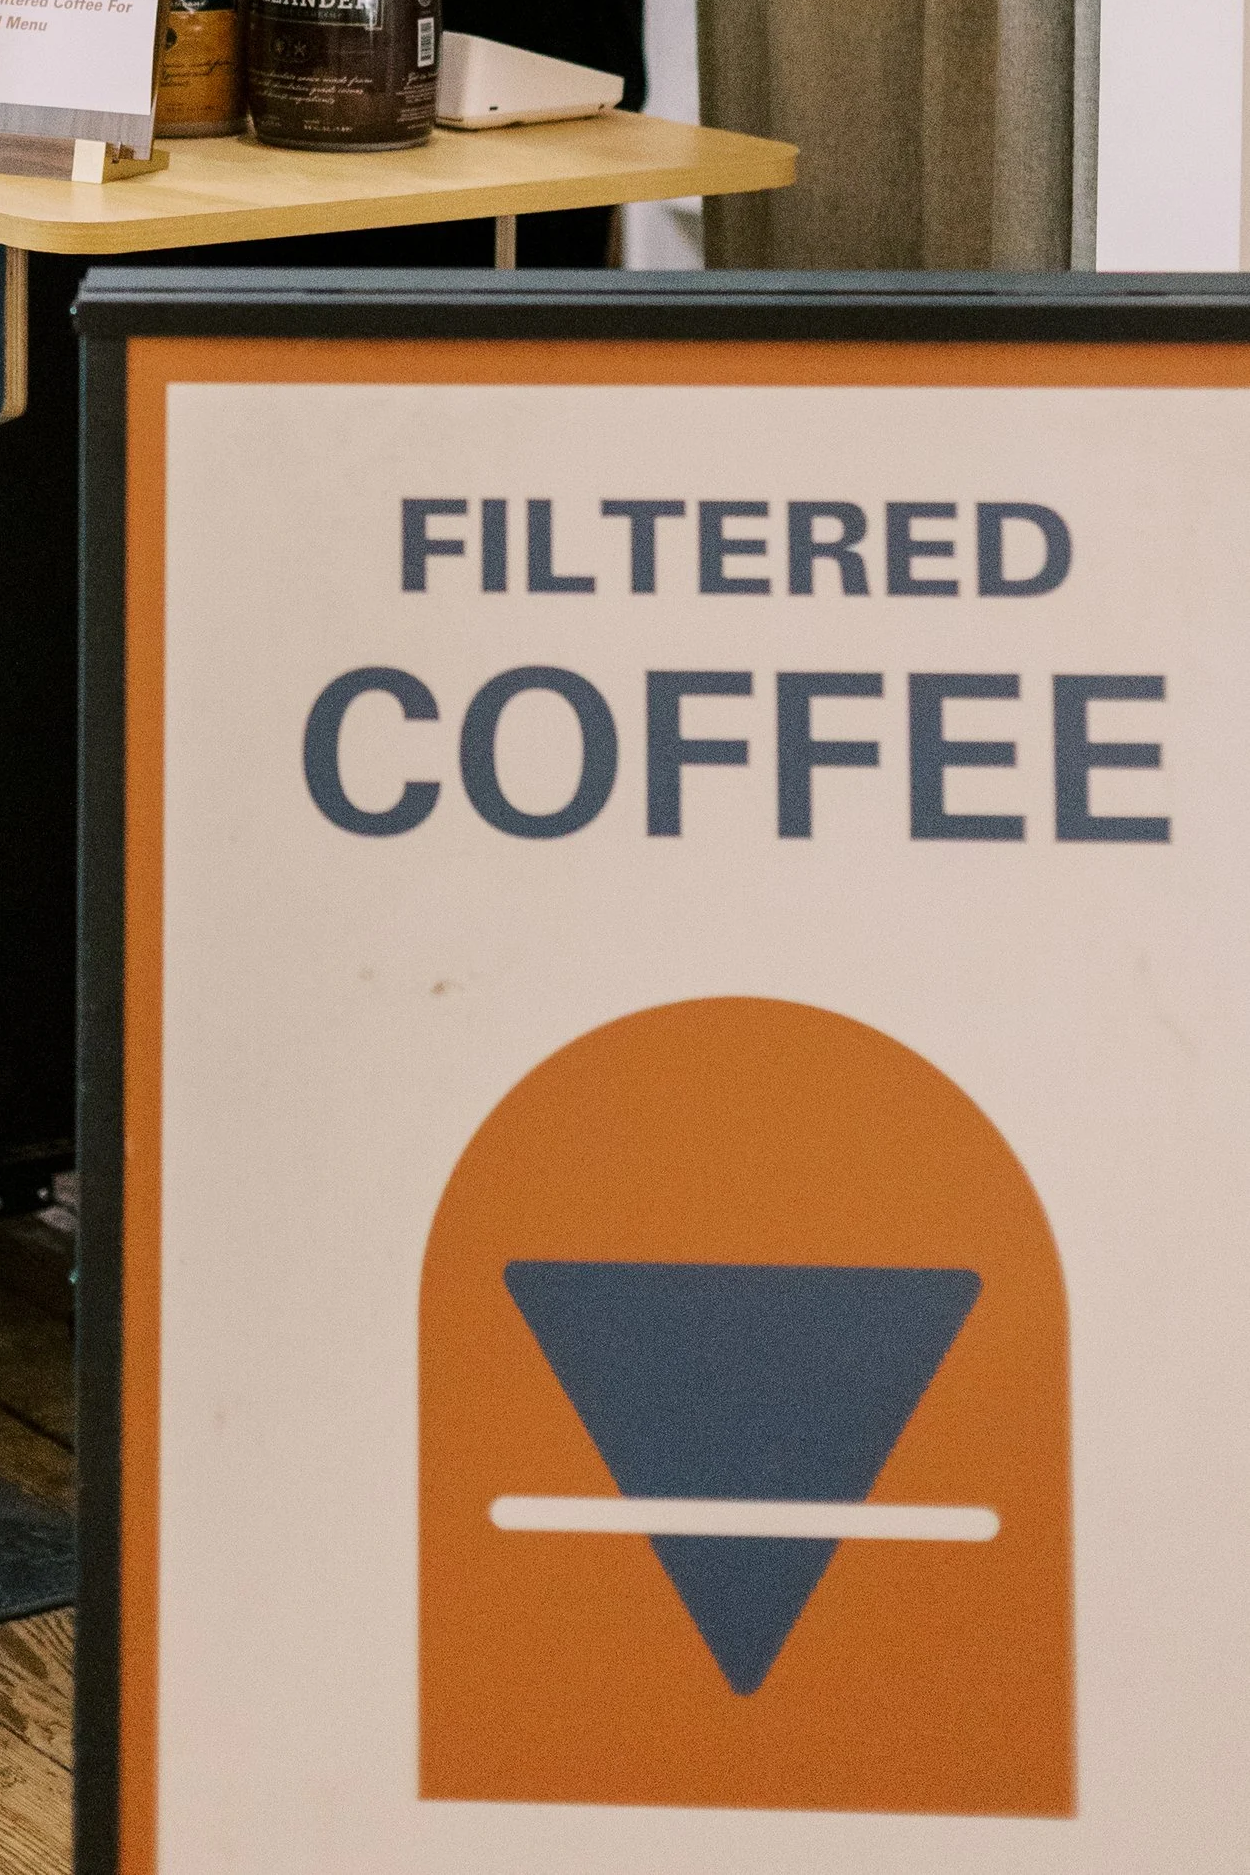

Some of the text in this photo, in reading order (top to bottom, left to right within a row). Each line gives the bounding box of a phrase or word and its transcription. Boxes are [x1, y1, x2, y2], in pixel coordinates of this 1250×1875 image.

[6, 16, 48, 32] Menu
[400, 498, 1073, 598] FILTERED
[302, 665, 1173, 844] COFFEE
